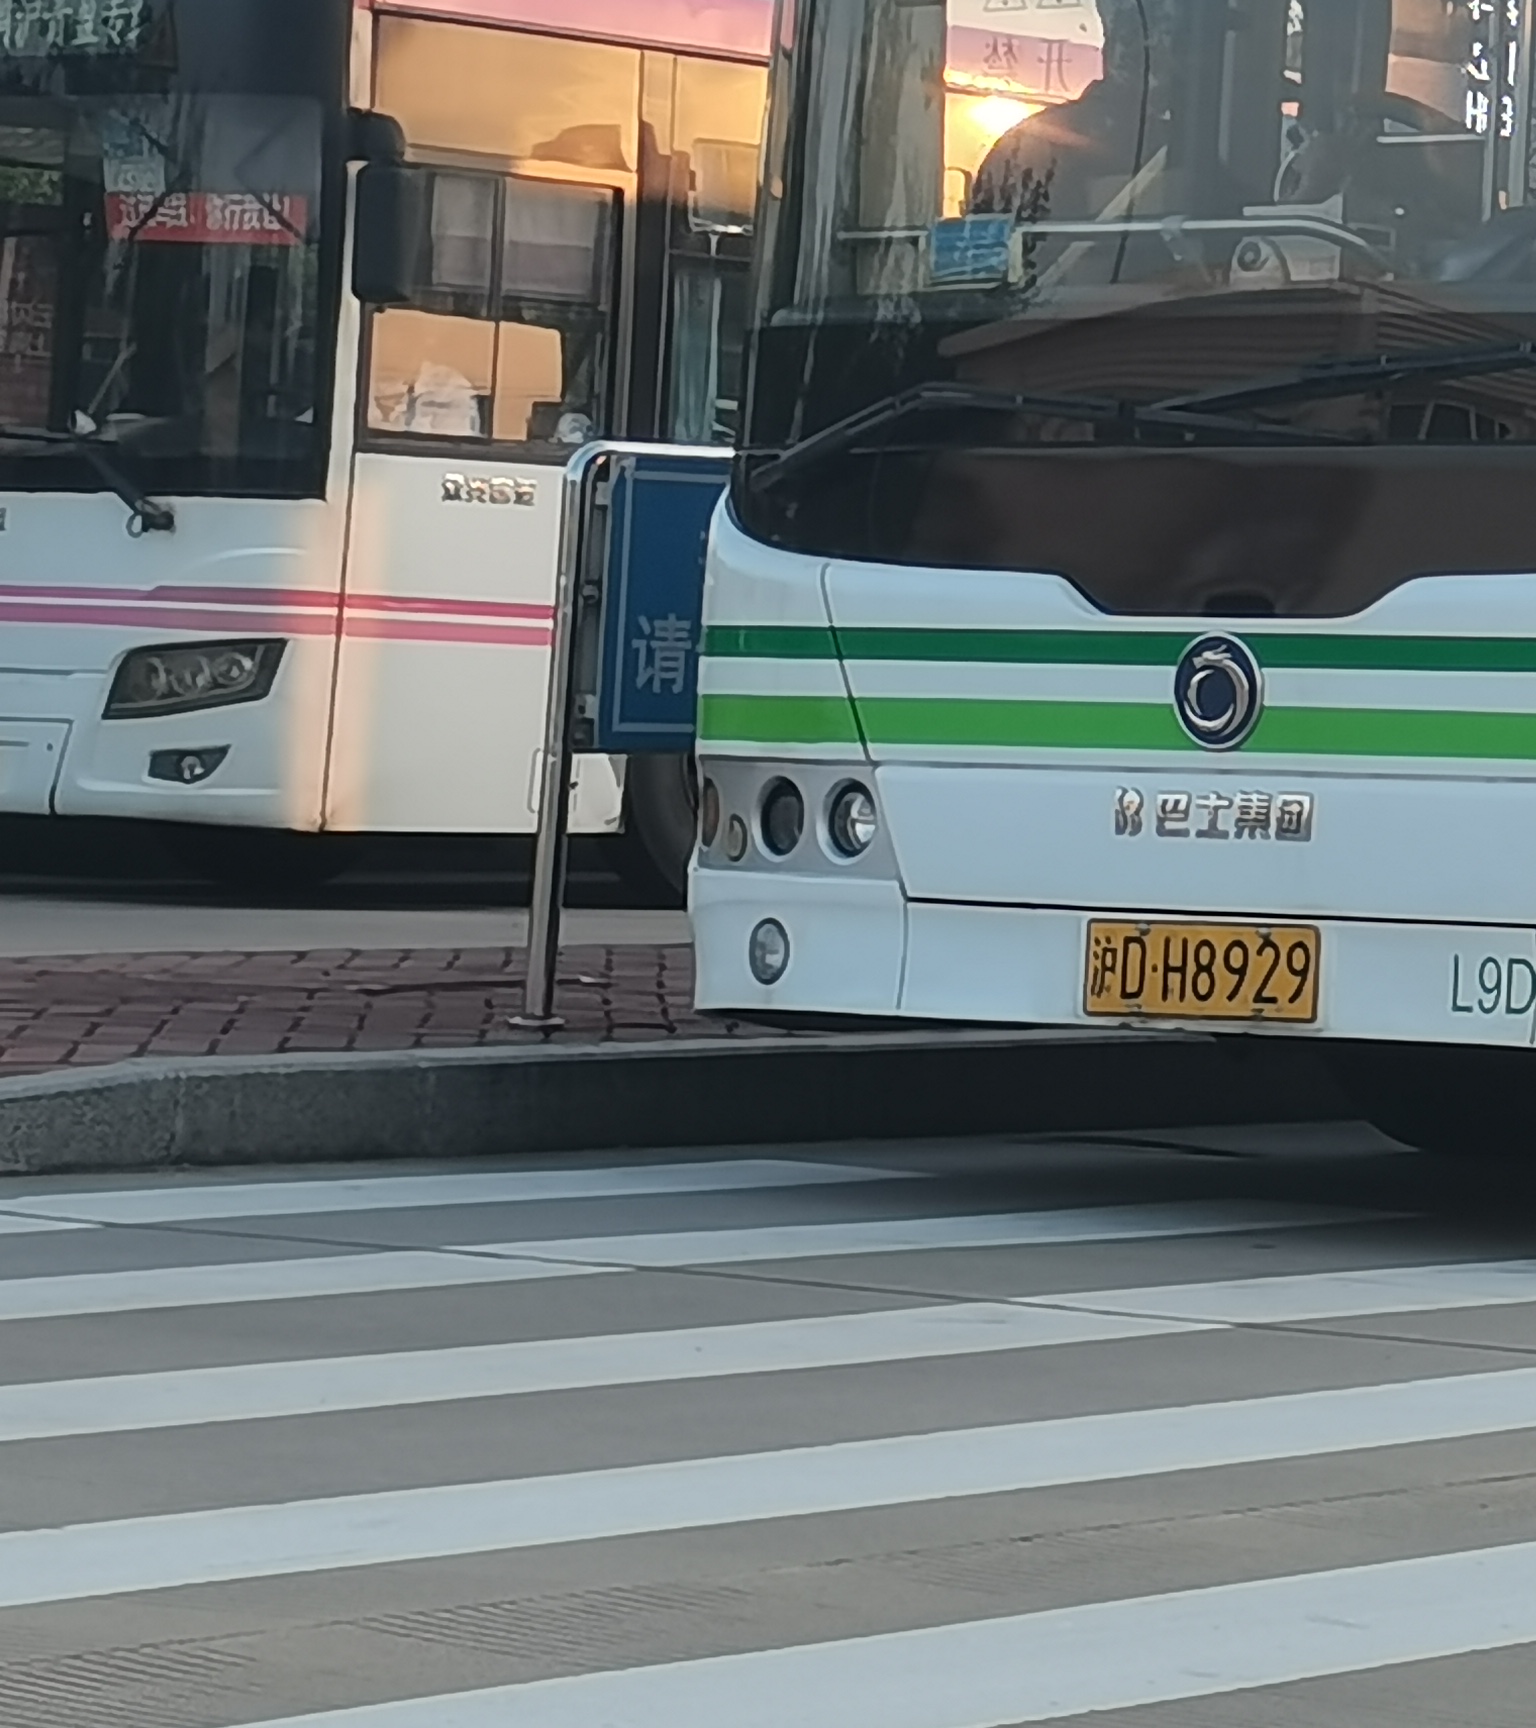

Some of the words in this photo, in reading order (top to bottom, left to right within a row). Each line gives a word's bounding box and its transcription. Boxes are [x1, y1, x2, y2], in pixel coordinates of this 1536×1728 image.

[630, 613, 693, 695] 请
[1155, 788, 1315, 843] 巴士集团
